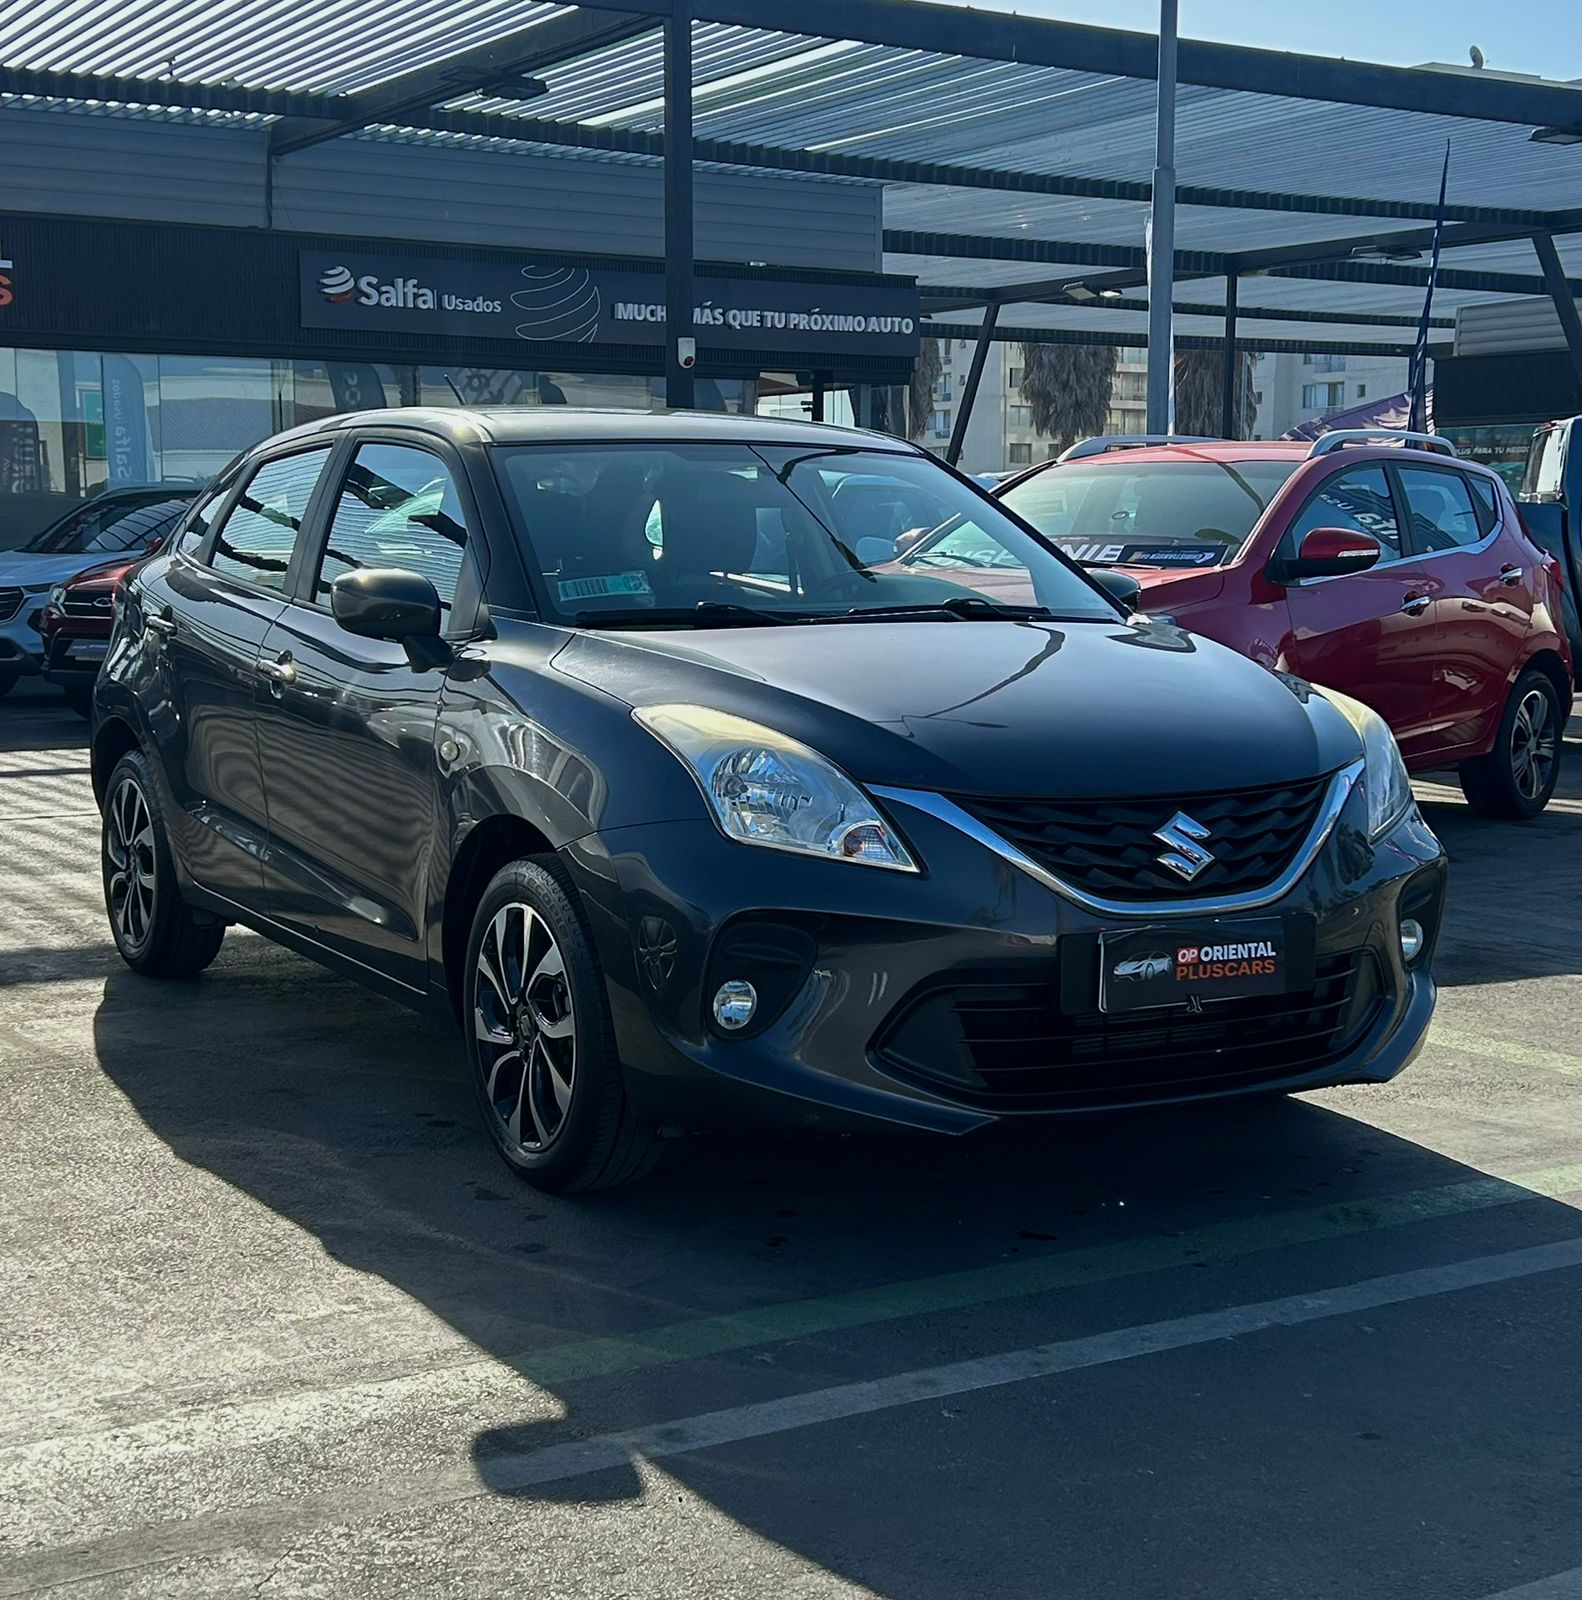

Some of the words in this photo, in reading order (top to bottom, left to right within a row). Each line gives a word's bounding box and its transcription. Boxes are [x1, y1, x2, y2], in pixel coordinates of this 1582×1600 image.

[357, 275, 434, 310] Salfa
[443, 294, 502, 313] Usados
[614, 302, 667, 322] MUCH
[725, 309, 761, 330] QUE
[762, 311, 786, 329] TU
[787, 308, 865, 333] PRÓXIMO
[866, 316, 914, 335] AUTO
[1177, 949, 1198, 963] OP
[1199, 941, 1277, 962] ORIENTAL
[1175, 959, 1276, 981] PLUSCARS
